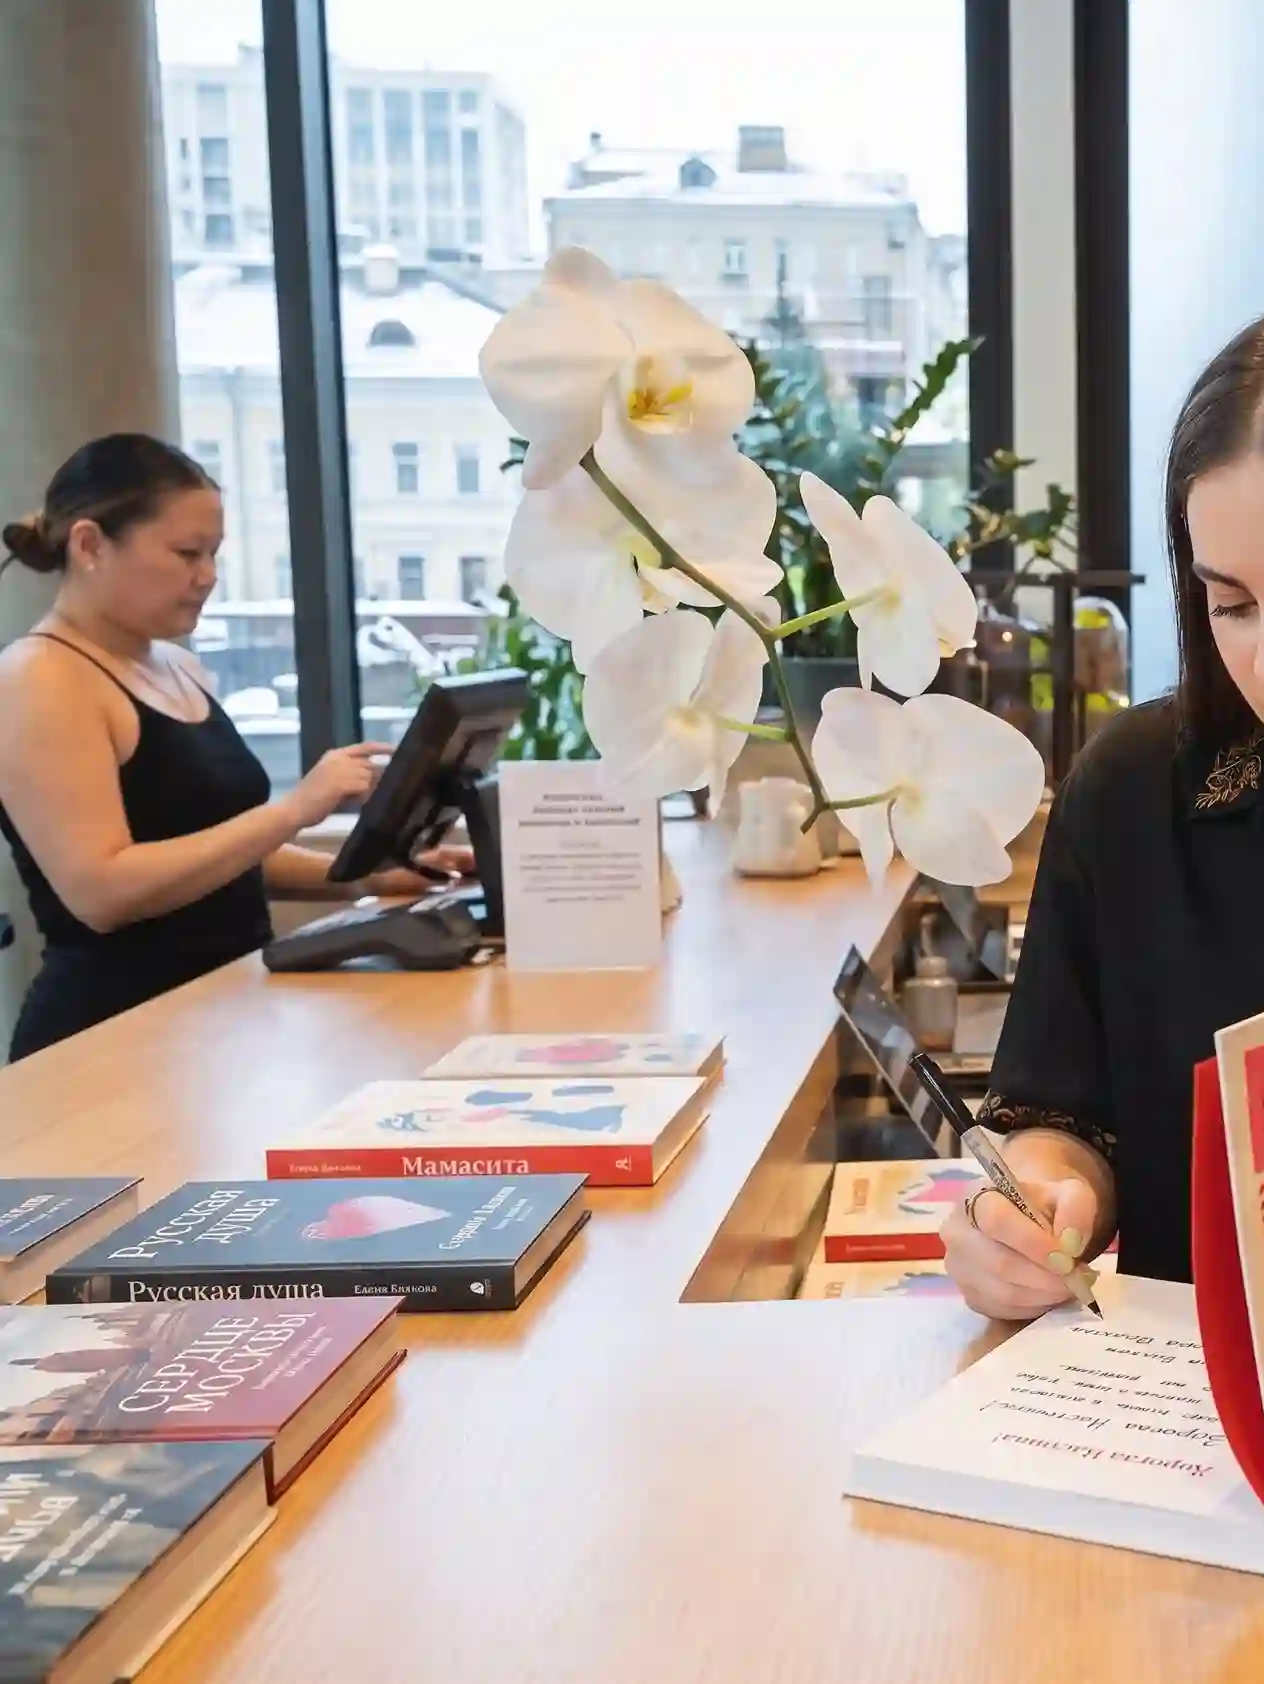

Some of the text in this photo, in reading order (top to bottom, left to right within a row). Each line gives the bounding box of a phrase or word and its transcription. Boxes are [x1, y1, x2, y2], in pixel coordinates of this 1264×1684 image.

[400, 1156, 529, 1175] Мамасита
[108, 1190, 244, 1258] Русская
[193, 1199, 281, 1243] душа
[119, 1317, 258, 1412] СЕРДЦЕ
[164, 1312, 316, 1413] МОСКВЫ
